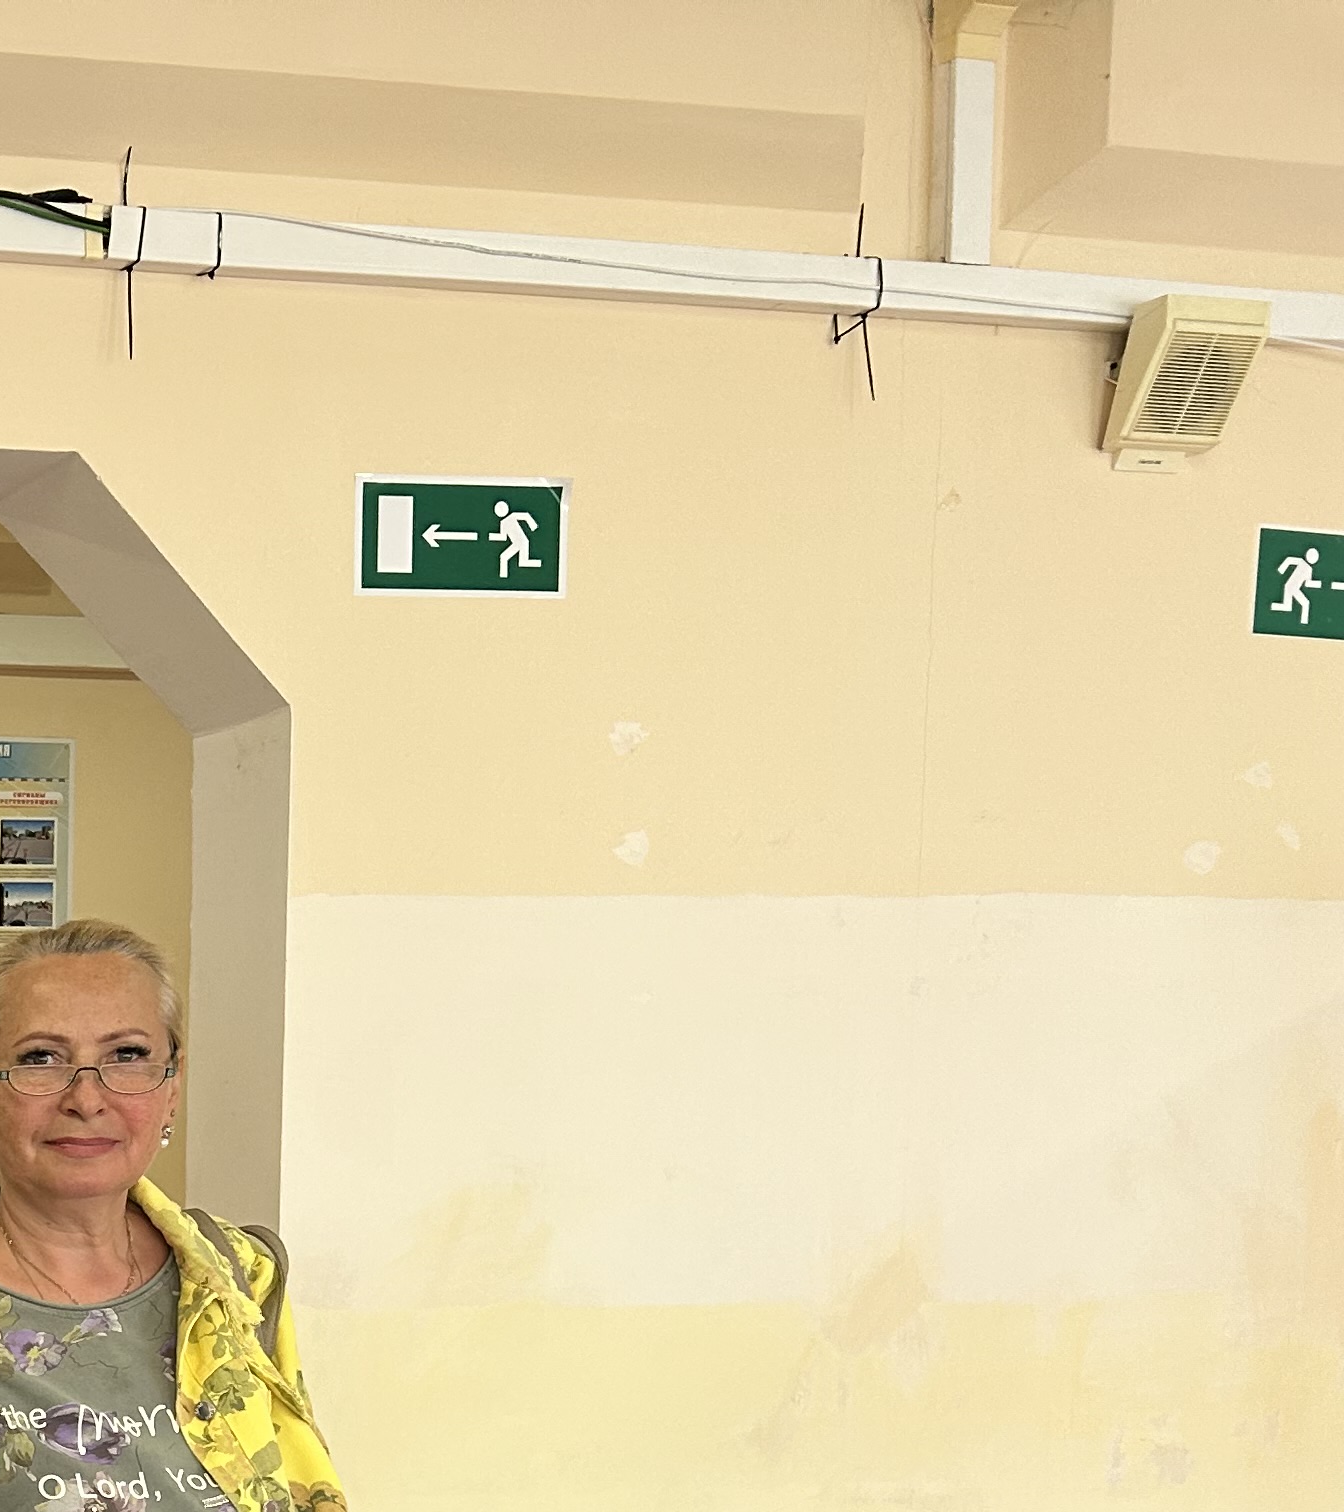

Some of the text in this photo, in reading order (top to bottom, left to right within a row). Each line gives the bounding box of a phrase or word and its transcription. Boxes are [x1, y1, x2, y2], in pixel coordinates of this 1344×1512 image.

[0, 1404, 47, 1430] the
[38, 1474, 67, 1500] O
[75, 1471, 162, 1502] Lord,
